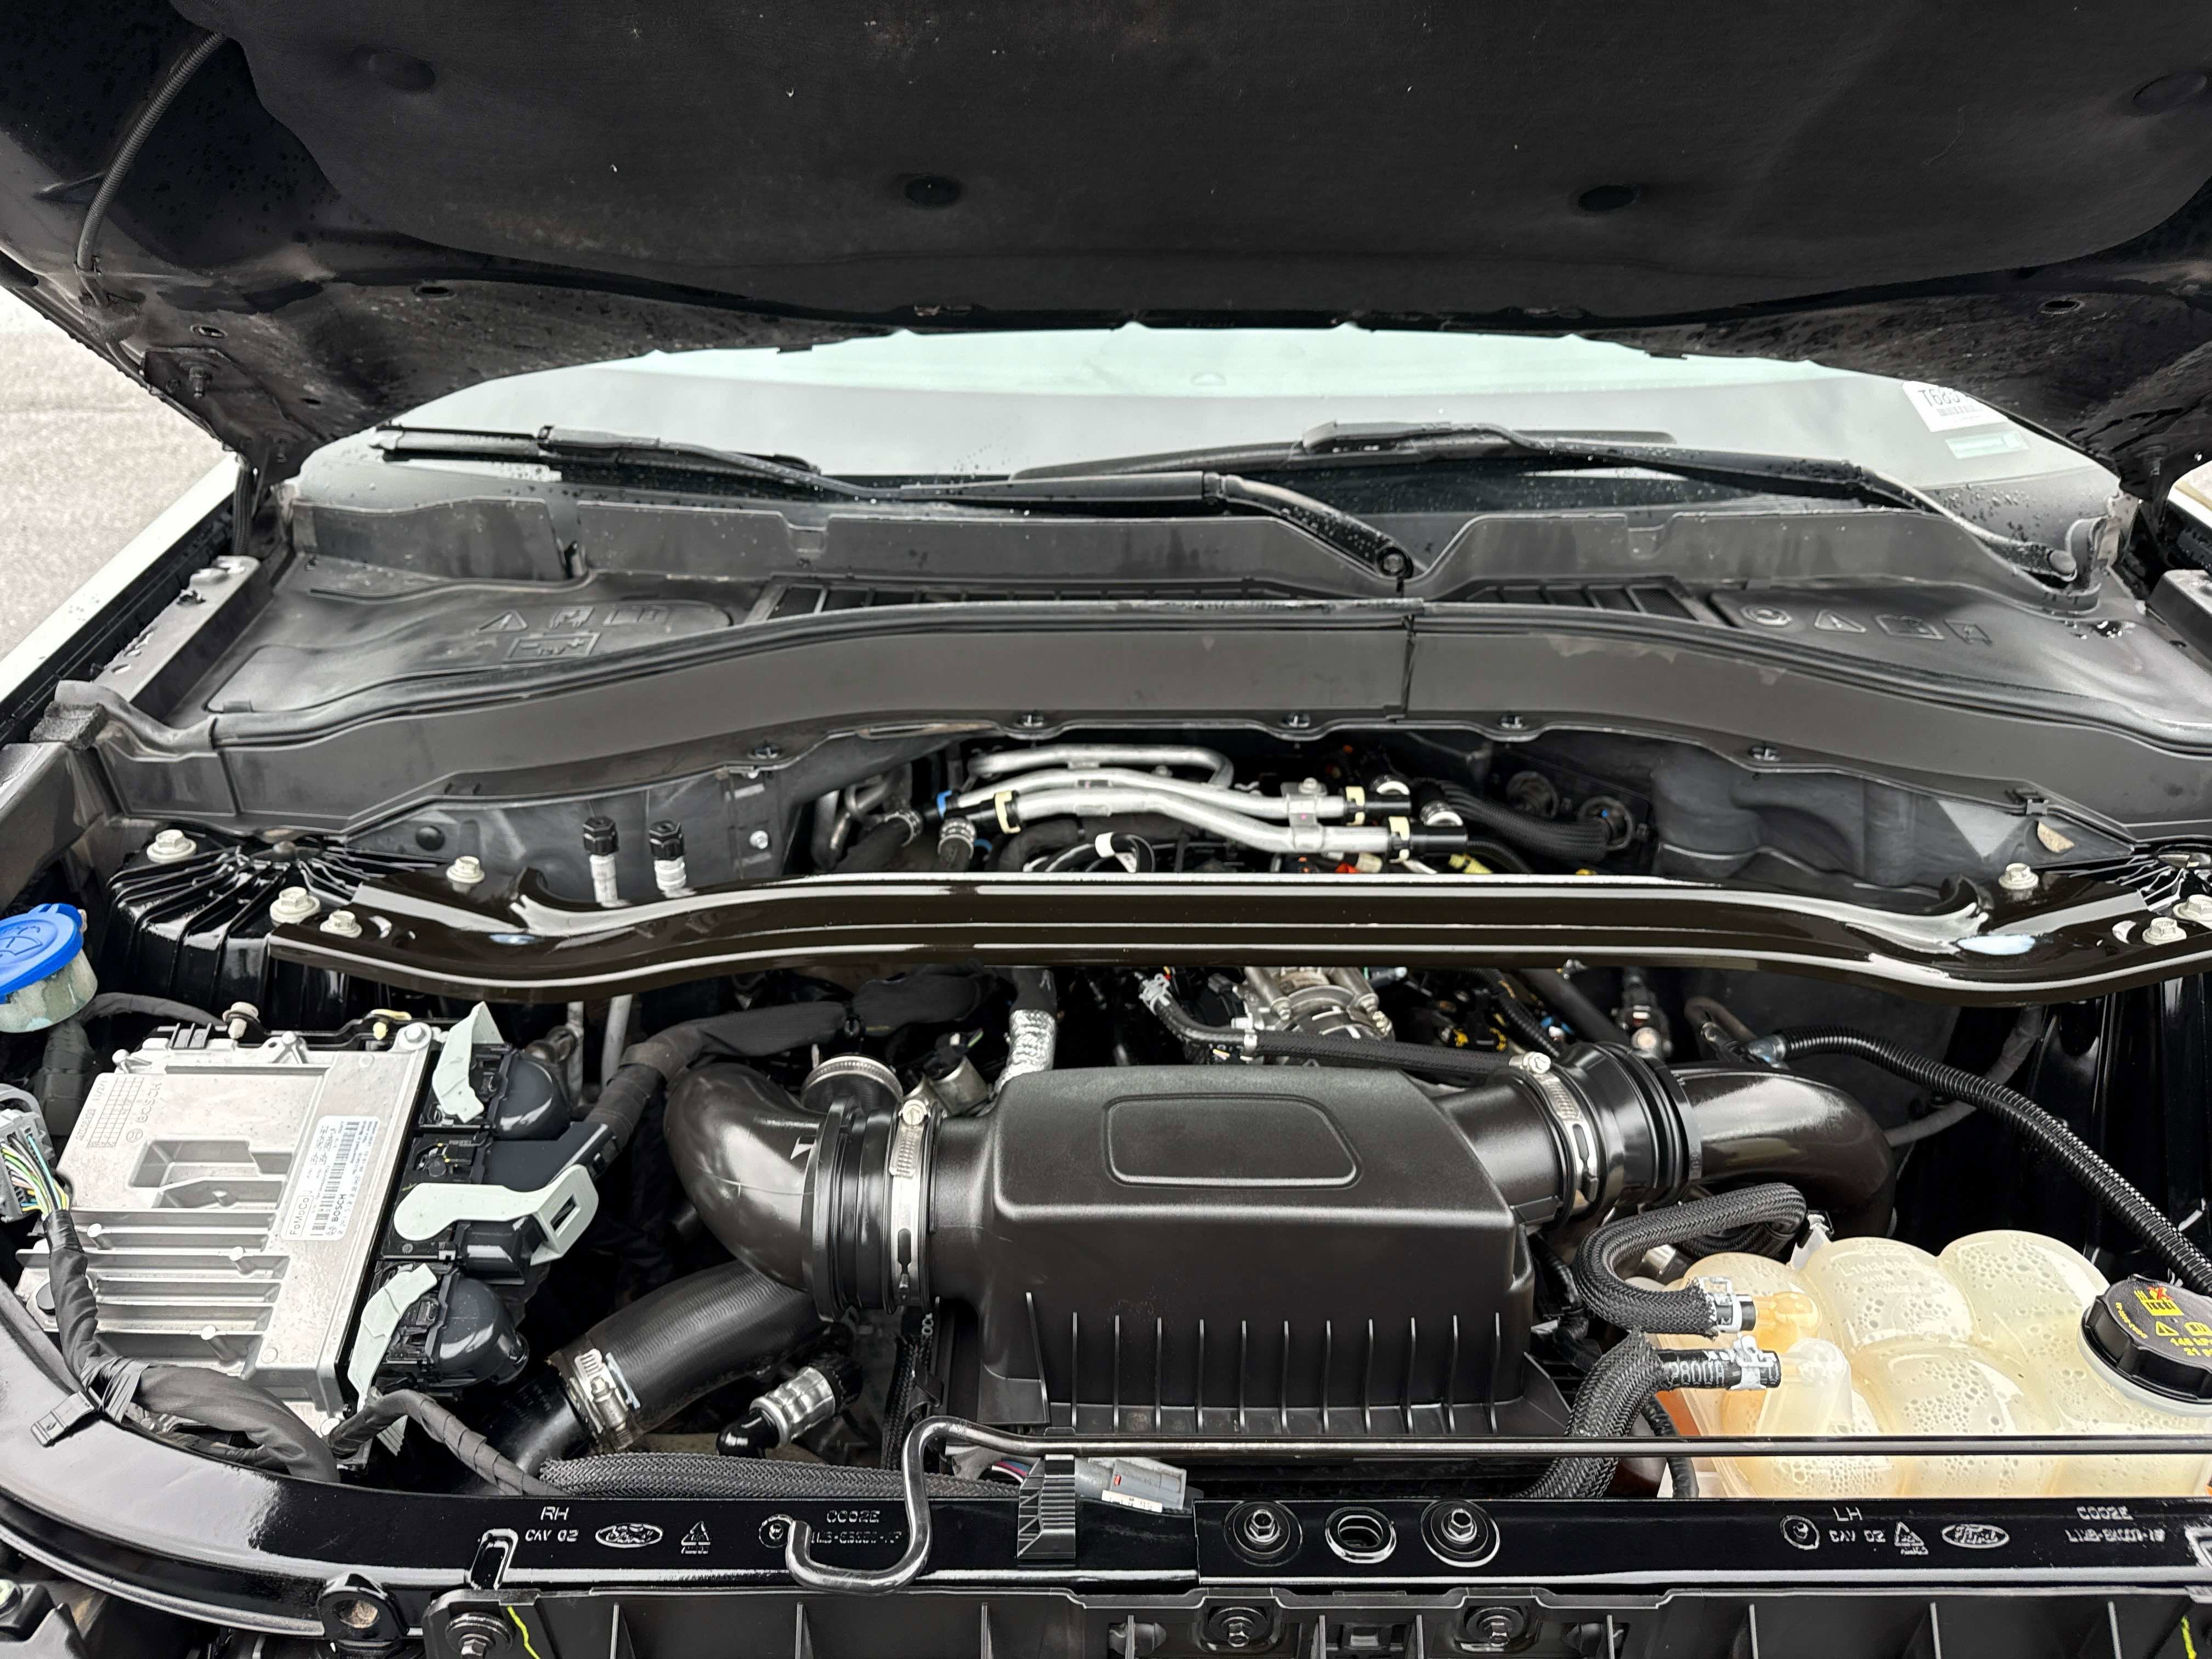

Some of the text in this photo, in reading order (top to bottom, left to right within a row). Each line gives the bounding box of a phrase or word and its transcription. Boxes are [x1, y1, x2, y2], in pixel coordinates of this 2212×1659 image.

[134, 1082, 162, 1123] BOSCH
[290, 1198, 309, 1235] FoMoCo
[331, 1194, 346, 1222] BOSCH
[2183, 1347, 2202, 1356] 21
[540, 1506, 570, 1521] RH
[1832, 1506, 1863, 1521] LH
[525, 1529, 579, 1542] CAV 02
[601, 1524, 658, 1547] Ford
[1829, 1530, 1855, 1543] CAV
[1864, 1530, 1886, 1543] 02
[1949, 1524, 2004, 1547] Ford
